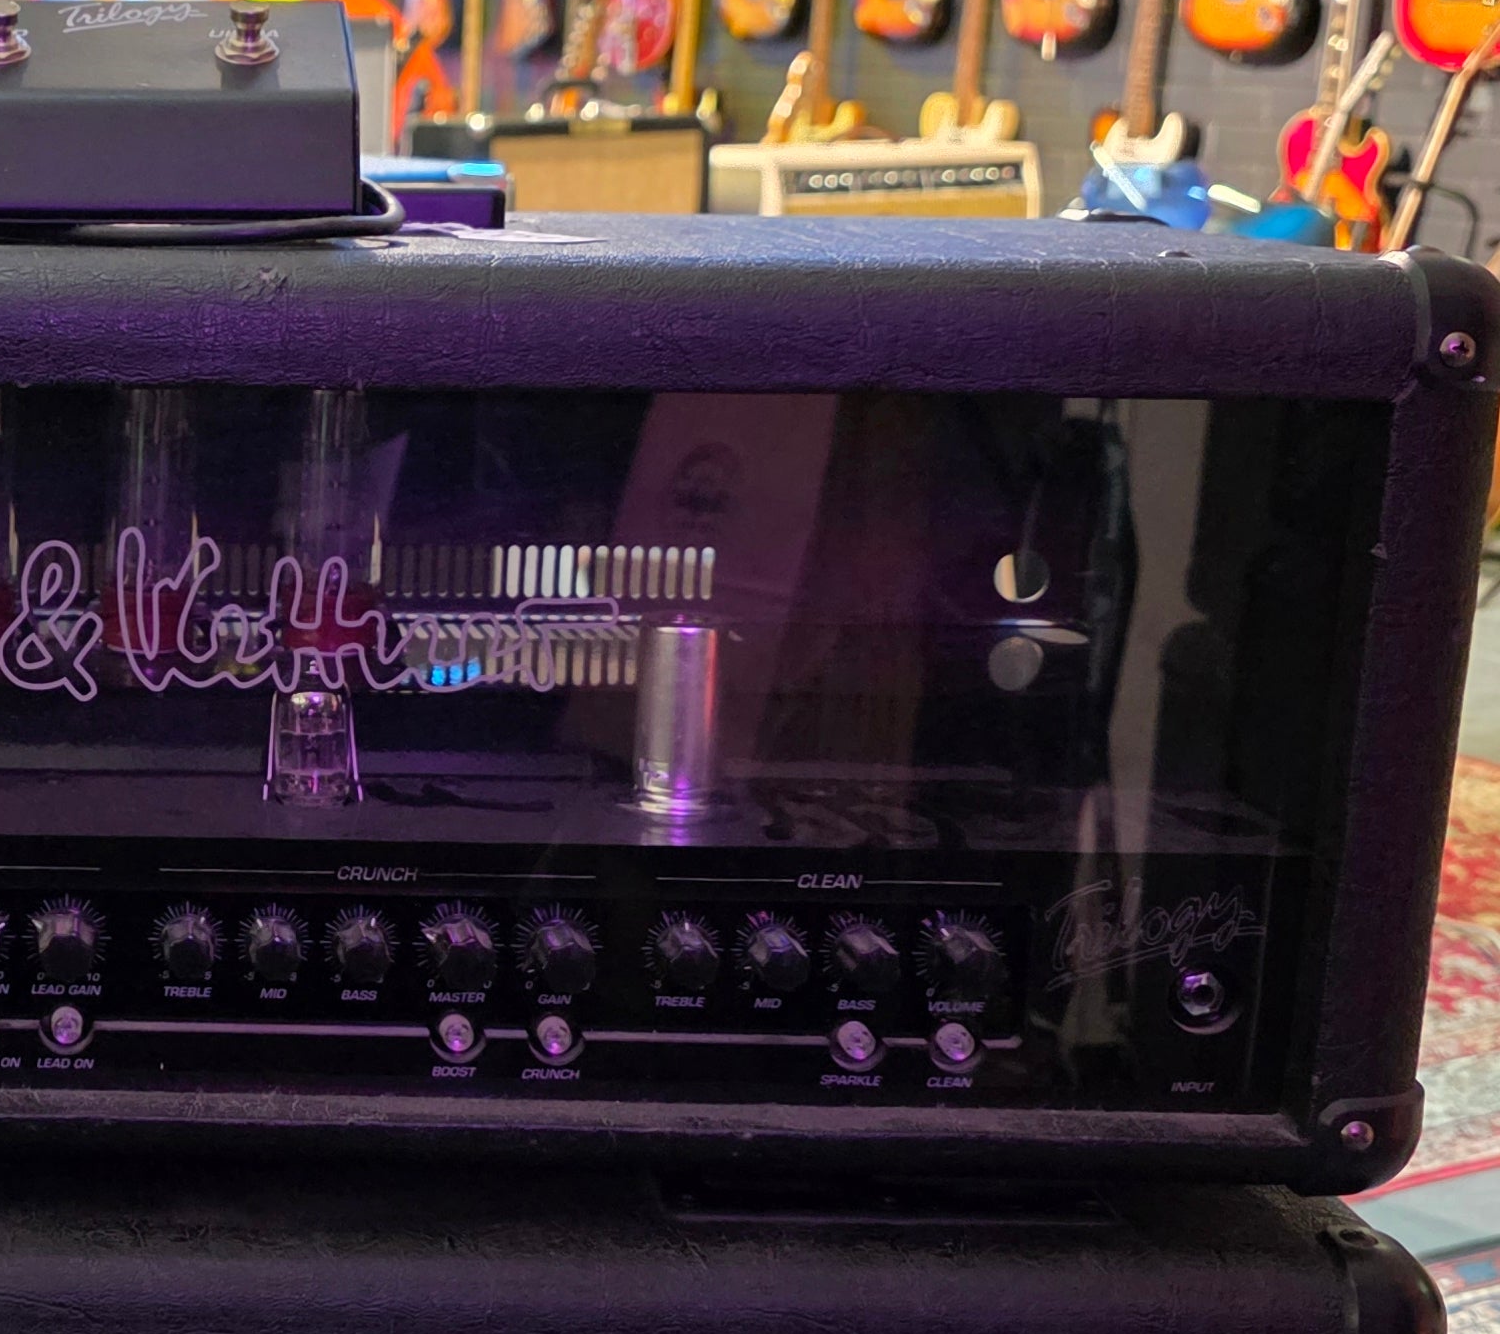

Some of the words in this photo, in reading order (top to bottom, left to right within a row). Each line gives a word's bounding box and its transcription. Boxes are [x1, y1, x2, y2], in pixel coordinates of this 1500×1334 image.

[57, 1, 209, 33] Trilogy
[116, 526, 621, 694] Kettner
[336, 866, 419, 883] CRUNCH
[796, 873, 863, 889] CLEAN
[1043, 877, 1268, 992] Trilogy
[85, 972, 101, 982] 10
[30, 983, 65, 995] LEAD
[67, 984, 102, 996] GAIN
[163, 985, 213, 998] TREBLE
[259, 987, 288, 1000] MID
[340, 989, 379, 1002] BASS
[428, 991, 486, 1003] MASTER
[537, 994, 572, 1005] GAIN
[654, 995, 707, 1008] TREBLE
[753, 997, 783, 1009] MID
[836, 999, 877, 1011] BASS
[927, 1000, 987, 1013] VOLUME
[0, 1056, 21, 1068] ON
[36, 1057, 71, 1069] LEAD
[73, 1057, 95, 1069] ON
[430, 1066, 478, 1078] BOOST
[520, 1068, 581, 1080] CRUNCH
[819, 1074, 884, 1087] SPARKLE
[925, 1076, 974, 1088] CLEAN
[1170, 1081, 1216, 1093] INPUT
